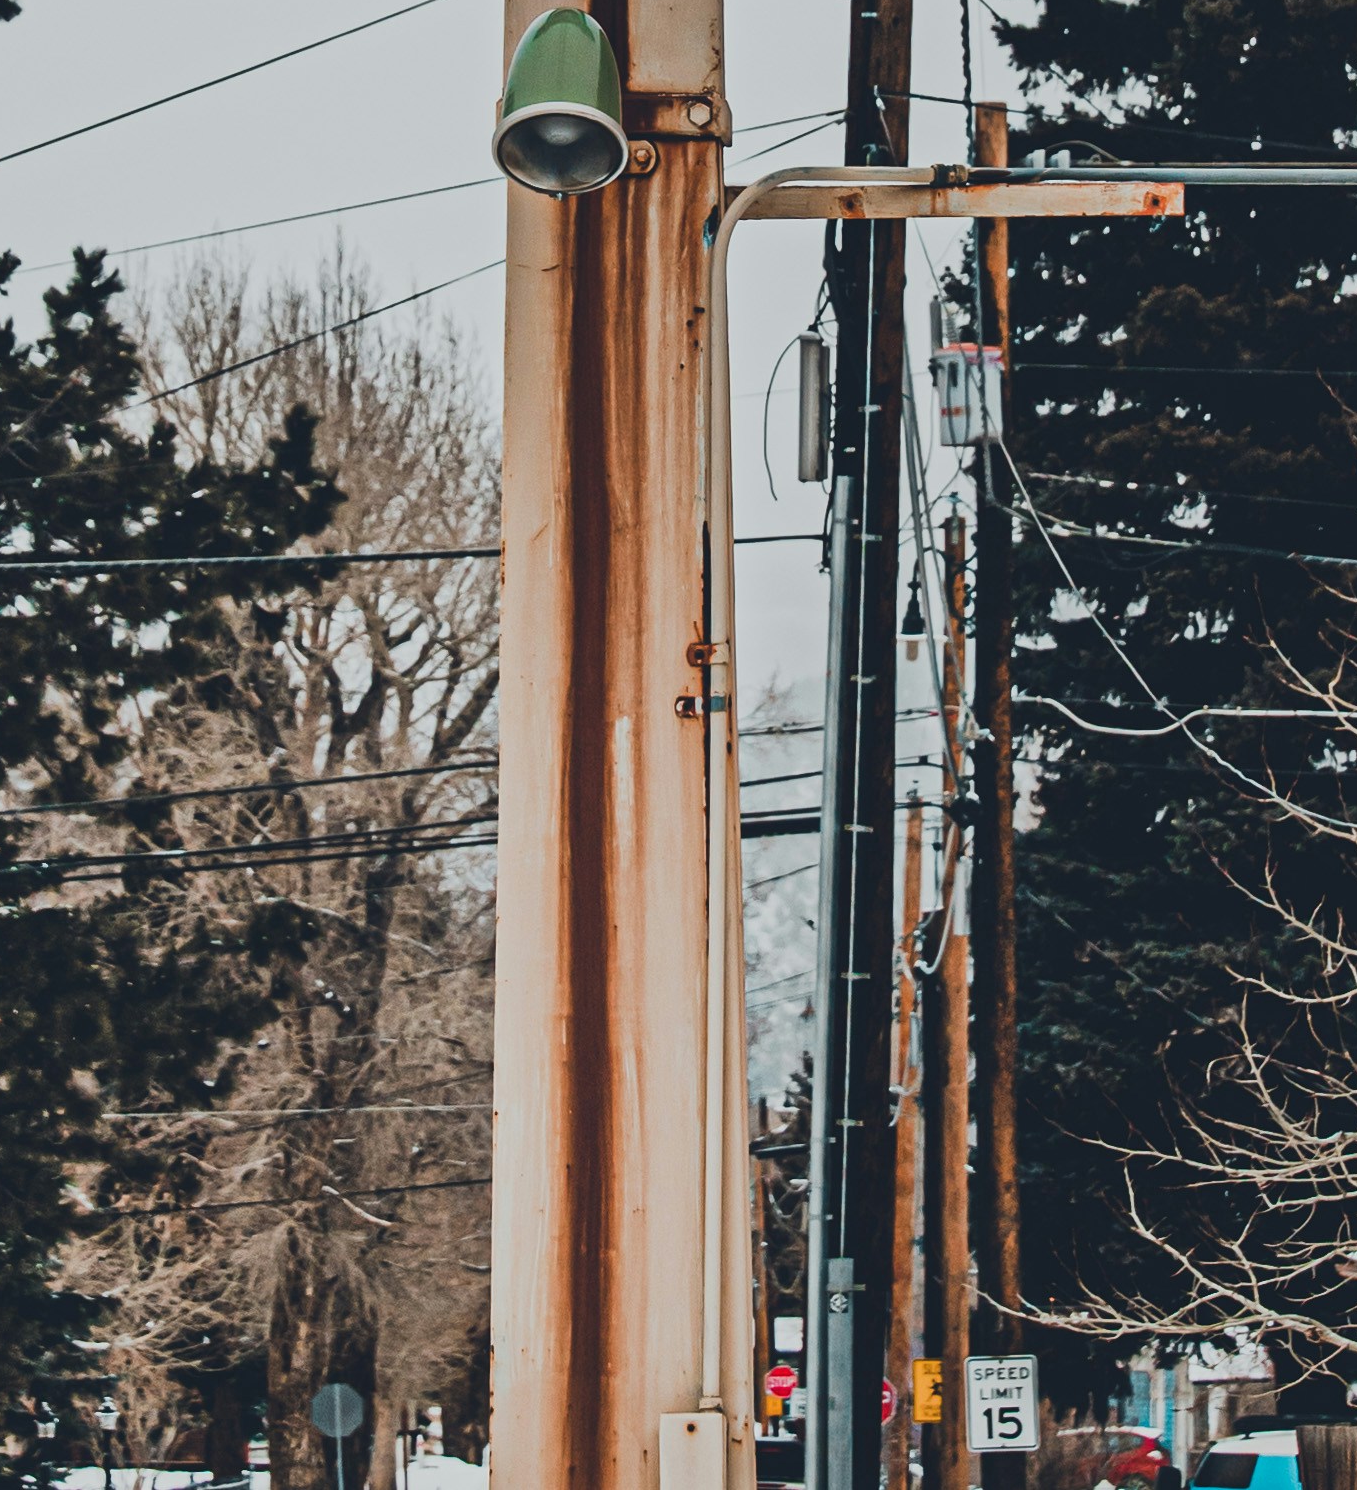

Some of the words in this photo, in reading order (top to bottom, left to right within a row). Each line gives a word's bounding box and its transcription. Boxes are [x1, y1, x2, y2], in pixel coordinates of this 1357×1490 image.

[974, 1367, 1030, 1381] SPEED
[979, 1387, 1024, 1401] LIMIT
[983, 1406, 1023, 1440] 15
